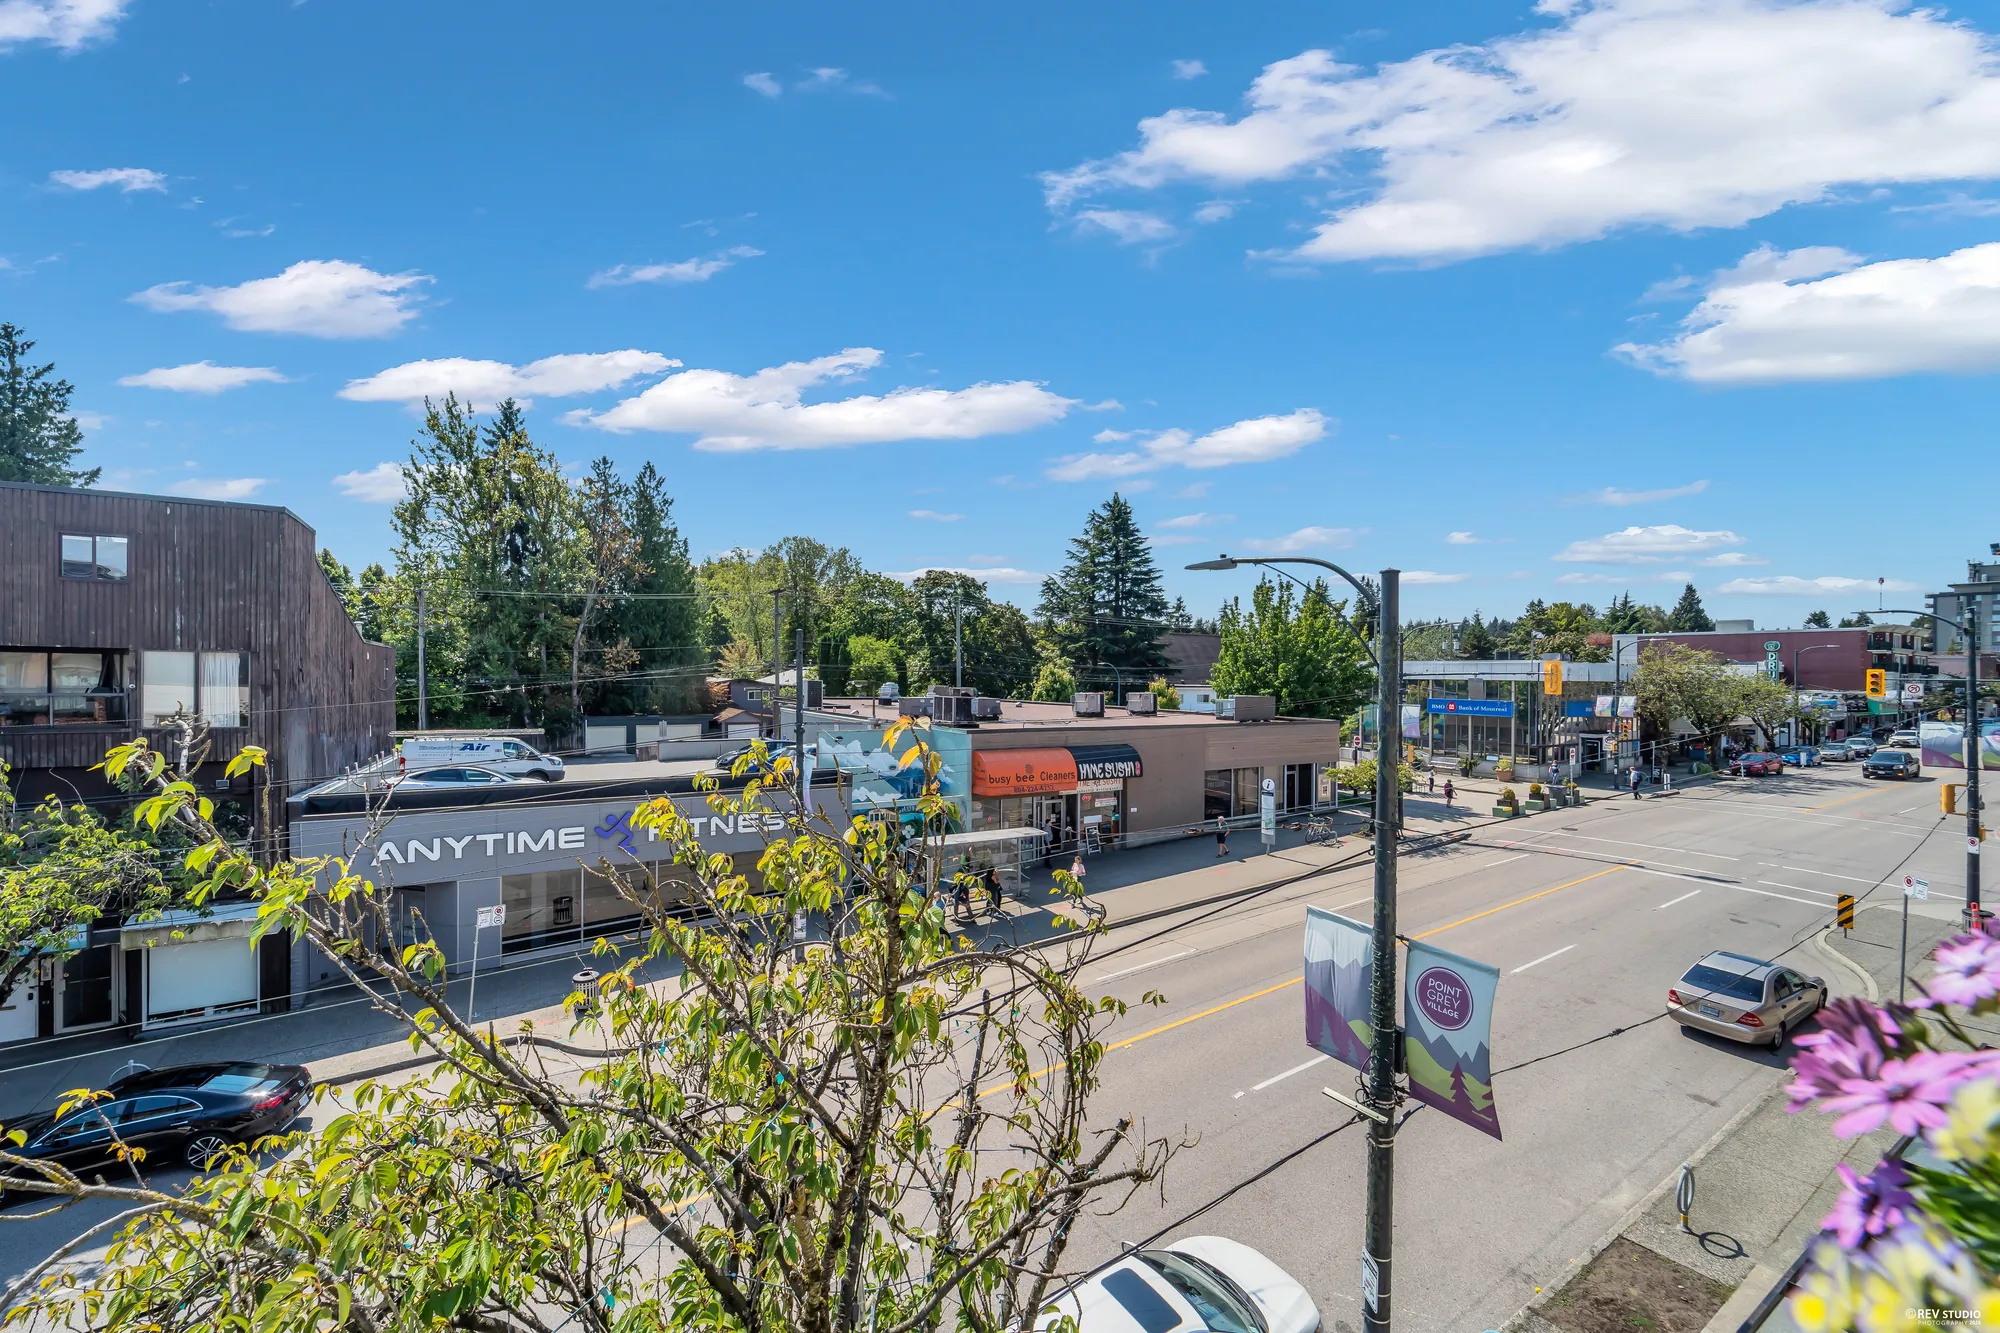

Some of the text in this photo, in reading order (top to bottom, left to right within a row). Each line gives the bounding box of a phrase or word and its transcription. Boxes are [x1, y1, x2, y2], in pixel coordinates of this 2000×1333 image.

[1767, 652, 1777, 680] DRU
[459, 742, 491, 751] Air
[988, 773, 1012, 785] busy
[1015, 772, 1035, 783] bee
[1039, 770, 1076, 782] Cleaners
[1078, 762, 1104, 780] HIME
[1104, 760, 1135, 778] SUSHI
[370, 826, 585, 867] ANYTIME
[1428, 977, 1462, 998] POINT
[1426, 989, 1461, 1010] GREY
[1426, 1000, 1459, 1019] VILLAGE
